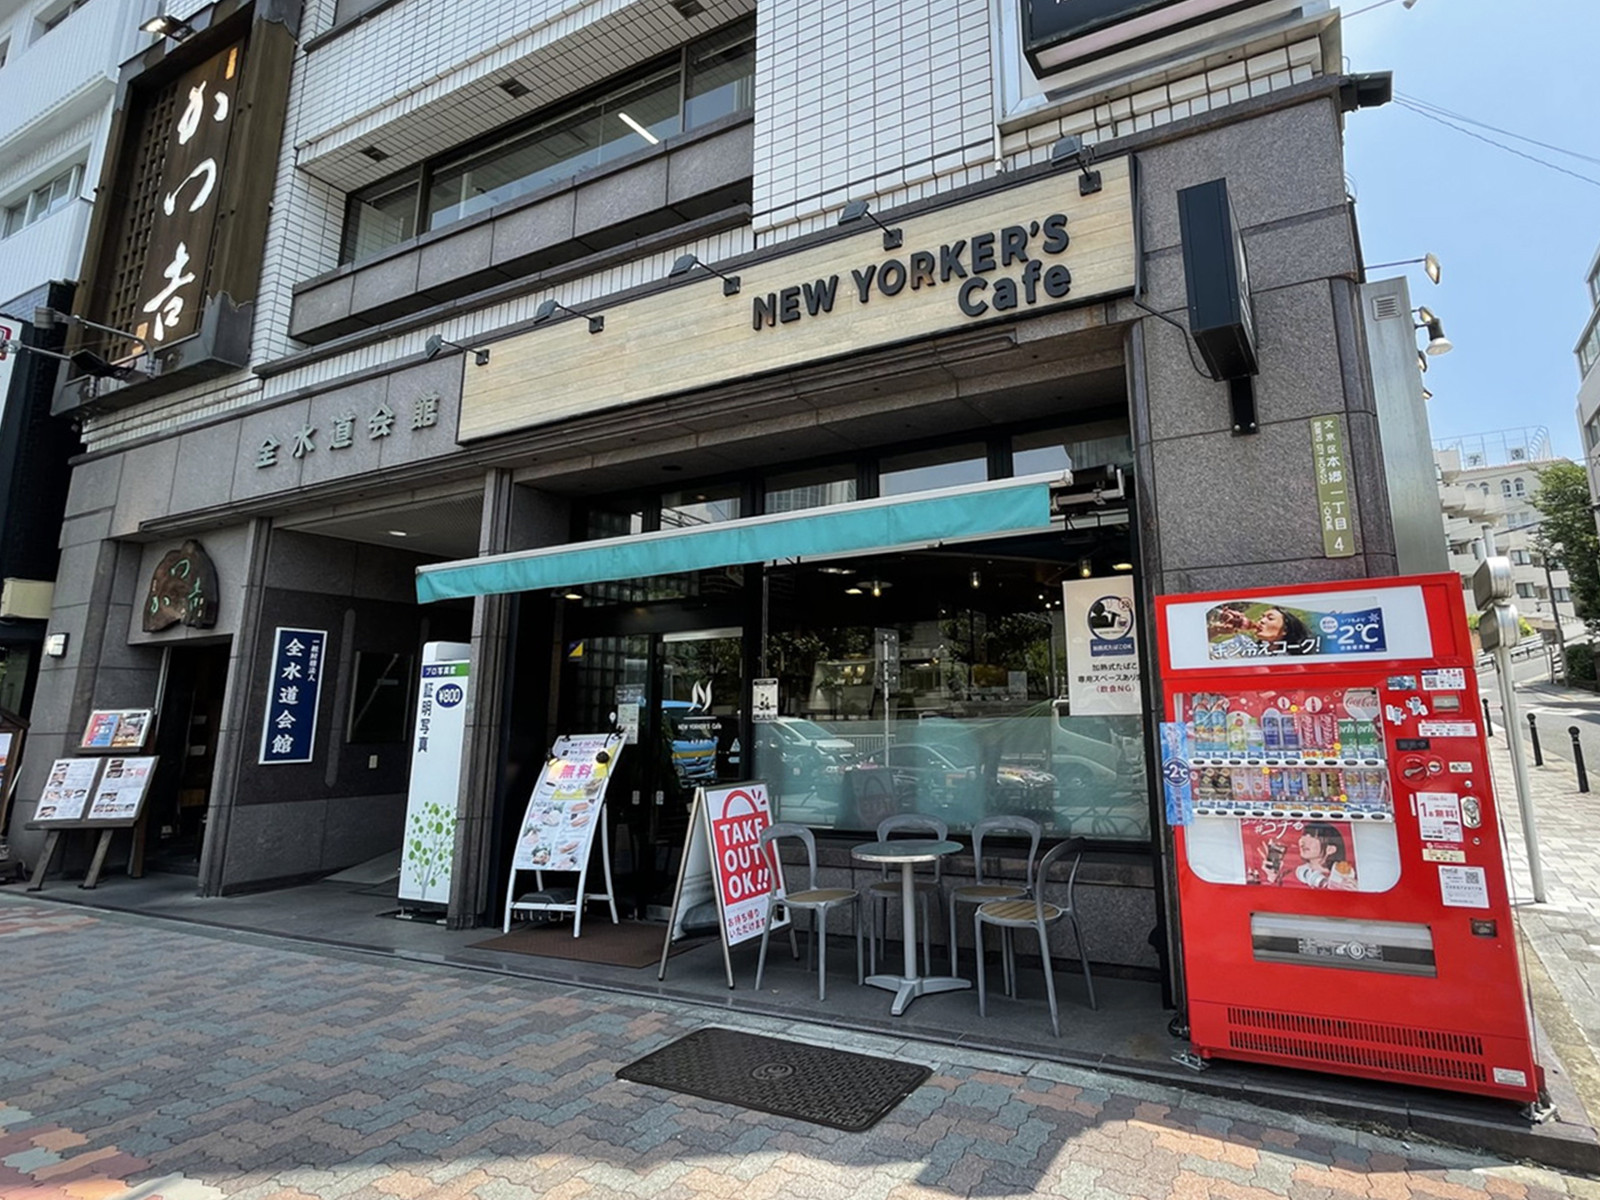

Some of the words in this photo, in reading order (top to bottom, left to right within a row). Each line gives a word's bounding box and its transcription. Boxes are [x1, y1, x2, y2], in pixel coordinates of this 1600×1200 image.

[144, 80, 229, 340] かつ吉
[753, 275, 839, 331] NEW
[851, 213, 1070, 303] YORKER'S
[958, 259, 1071, 317] Cafe
[254, 391, 440, 469] 全水道会館
[1334, 536, 1344, 551] 4
[1092, 662, 1137, 672] 加熱式たばこ
[271, 637, 306, 754] 全水道会館
[439, 688, 461, 703] ¥800
[559, 763, 593, 779] 無料
[719, 817, 764, 846] TAKE
[724, 843, 761, 873] OUT
